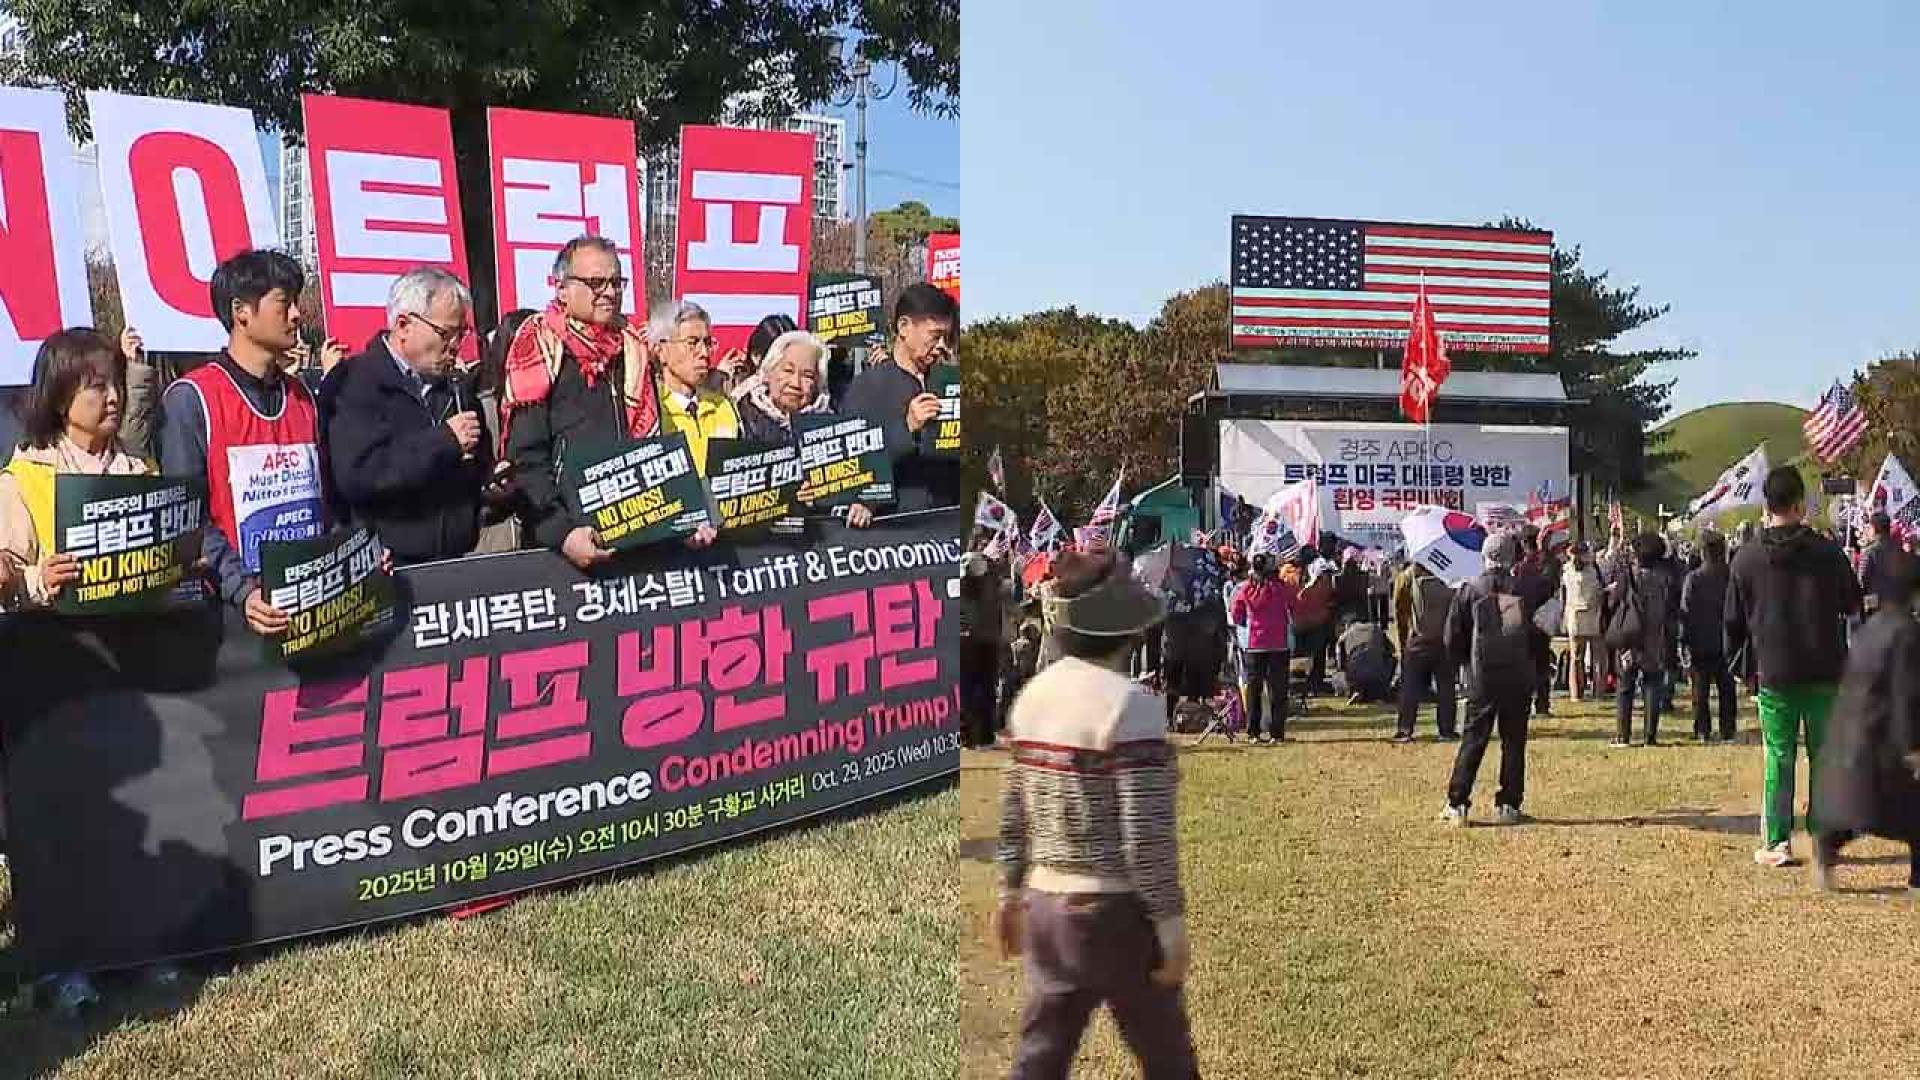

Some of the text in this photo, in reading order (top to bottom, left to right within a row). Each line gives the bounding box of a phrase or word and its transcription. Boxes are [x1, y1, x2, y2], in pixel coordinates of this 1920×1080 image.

[818, 316, 834, 331] NO
[262, 450, 300, 471] APEC
[800, 427, 884, 469] 트럼프 반대!
[1340, 439, 1453, 463] 경주 APEC
[249, 472, 279, 487] Must
[578, 446, 691, 514] 트럼프 반대!
[711, 466, 767, 499] 트럼프
[810, 456, 860, 487] NO KINGS!
[1284, 464, 1512, 487] 트럼프 미국 대통령 방한
[596, 506, 619, 529] NO
[618, 486, 666, 520] KINGS!
[718, 487, 781, 518] NO KINGS!
[1334, 488, 1375, 511] 환영
[65, 512, 154, 558] 트럼프
[160, 496, 201, 542] 반대!
[83, 541, 174, 585] NO KINGS!
[75, 580, 121, 602] TRUMP
[122, 576, 145, 595] NOT
[271, 562, 345, 617] 트럼프
[412, 586, 567, 649] 관세폭탄,
[572, 564, 704, 622] 경제수탈!
[713, 558, 799, 596] Tariff
[805, 552, 829, 580] &
[286, 611, 312, 641] NO
[315, 581, 364, 628] KINGS!
[242, 576, 943, 821] 트럼프 방한 규탄
[258, 823, 394, 878] Press
[401, 769, 652, 849] Conference
[658, 716, 865, 793] Condemning
[868, 693, 949, 737] Trump
[359, 862, 436, 901] 2025년
[442, 851, 488, 884] 10월
[493, 835, 574, 873] 29일(수)
[577, 823, 616, 854] 오전
[620, 811, 660, 844] 10시
[664, 804, 704, 833] 30분
[707, 789, 758, 824] 구황교
[761, 773, 805, 809] 사거리
[842, 760, 862, 784] 29,
[864, 749, 897, 777] 2025
[897, 740, 931, 768] (Wed)
